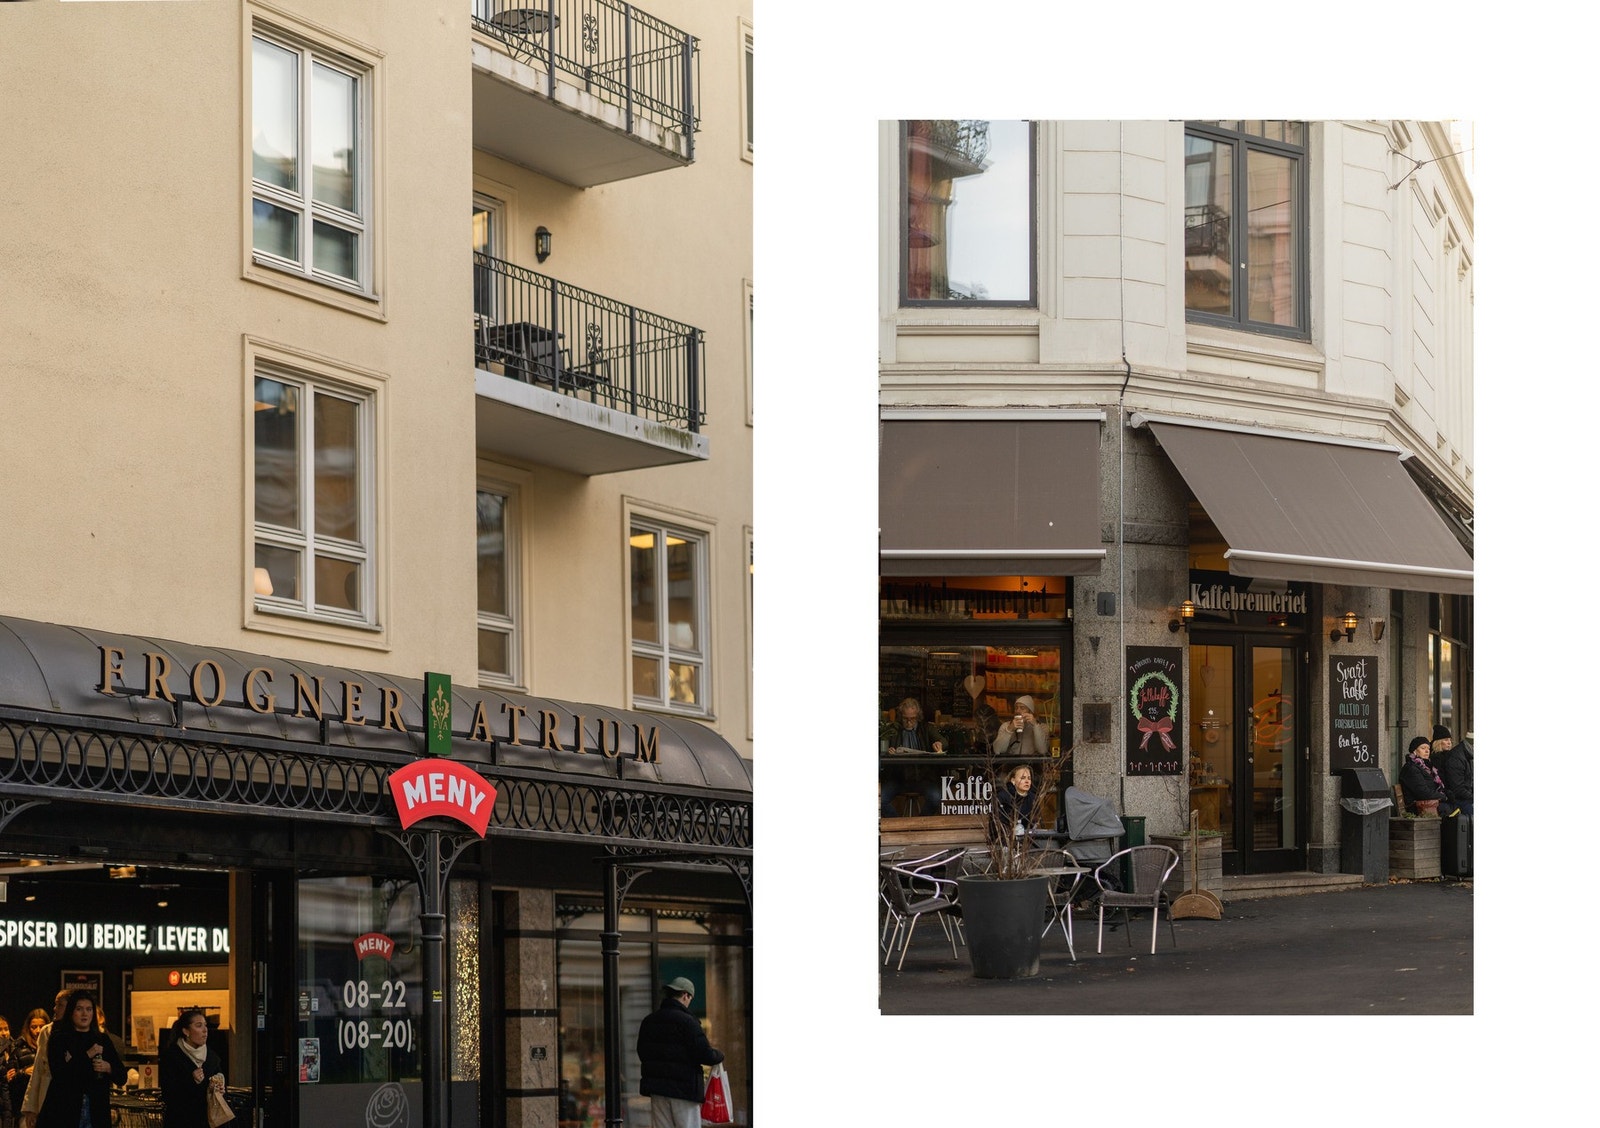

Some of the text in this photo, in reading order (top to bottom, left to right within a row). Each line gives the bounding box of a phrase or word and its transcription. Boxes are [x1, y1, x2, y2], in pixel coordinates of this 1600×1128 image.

[1190, 583, 1307, 614] Kaffebrenneriet
[1336, 658, 1368, 682] Svart
[1342, 678, 1369, 701] kaffe
[97, 645, 662, 765] FROGNER ATRIUM
[1338, 702, 1370, 716] ALLTID TO
[402, 772, 487, 815] MENY
[941, 775, 993, 801] Kaffe
[941, 802, 992, 815] brenneriet
[0, 919, 58, 949] SPISER
[64, 921, 88, 949] DU
[93, 923, 153, 955] BEDRE,
[157, 925, 208, 952] LEVER
[358, 937, 391, 954] MENY
[181, 972, 207, 984] KAFFE
